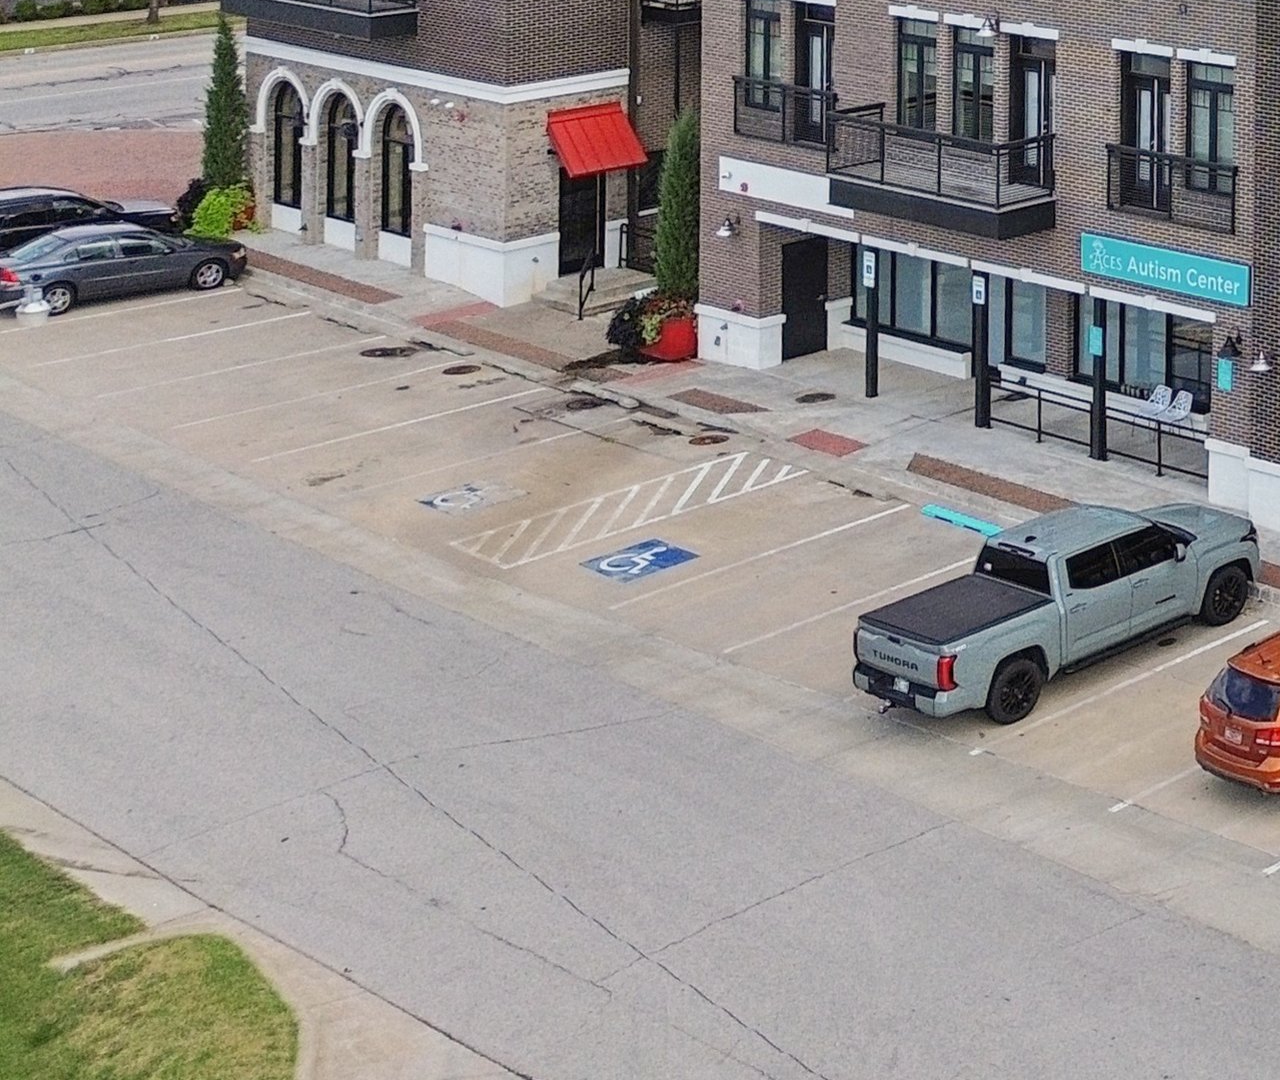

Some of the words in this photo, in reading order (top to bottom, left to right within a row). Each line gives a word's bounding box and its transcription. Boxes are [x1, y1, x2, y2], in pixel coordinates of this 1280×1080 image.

[1093, 248, 1123, 271] ACES
[1127, 256, 1181, 283] Autism
[1186, 268, 1240, 295] Center
[873, 650, 918, 671] TUNDRA
